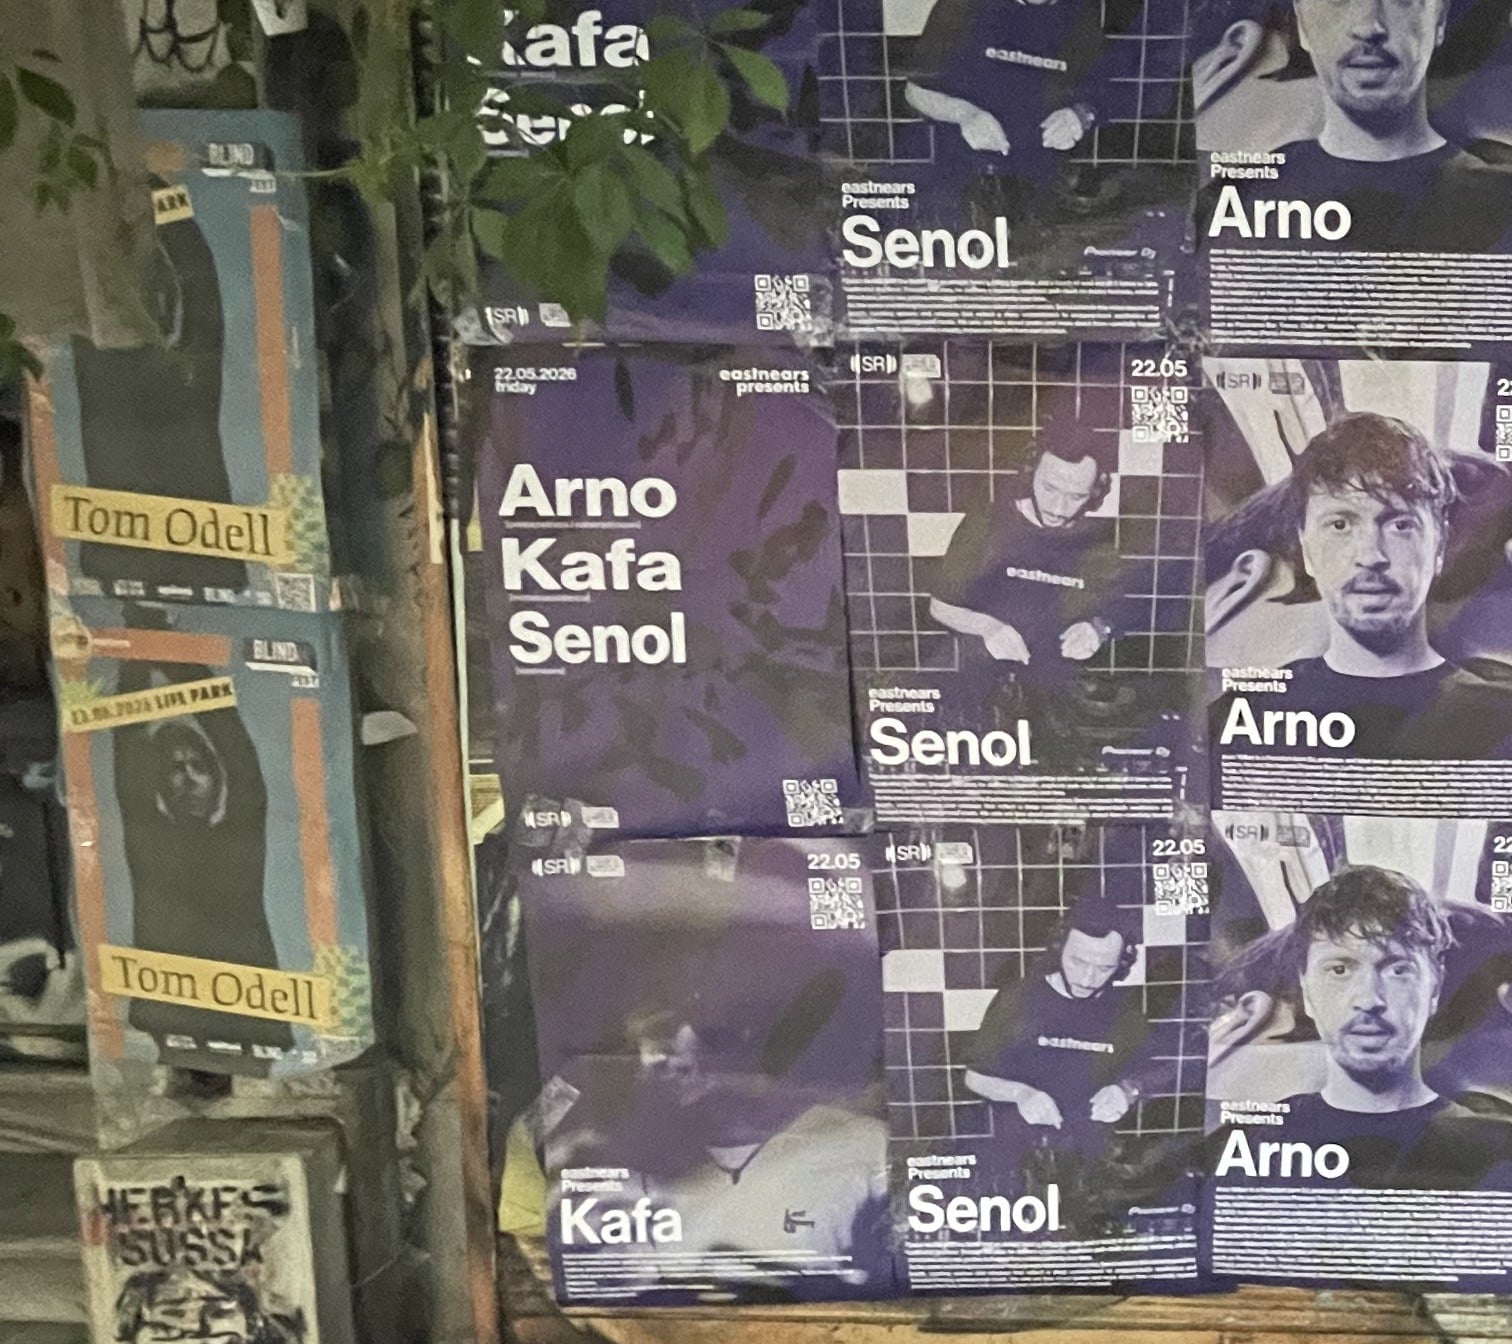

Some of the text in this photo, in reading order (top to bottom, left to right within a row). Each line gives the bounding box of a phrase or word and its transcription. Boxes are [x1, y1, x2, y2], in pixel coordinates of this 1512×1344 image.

[1210, 151, 1286, 165] eastnears
[1211, 165, 1278, 180] Presents
[841, 181, 915, 195] eastnears
[842, 195, 909, 210] Presents
[1208, 185, 1351, 240] Arno
[842, 215, 1009, 269] Senol
[492, 306, 520, 325] SR
[862, 357, 885, 373] SR
[1132, 359, 1188, 378] 22.05
[494, 368, 577, 381] 22.05.2026
[720, 369, 810, 381] eastnears
[1228, 373, 1251, 388] SR
[736, 381, 809, 396] presents
[500, 464, 677, 518] Arno
[65, 495, 275, 557] Tom Odell
[502, 538, 682, 591] Kafa
[508, 611, 687, 665] Senol
[1221, 668, 1293, 680] eastnears
[869, 687, 941, 700] eastnears
[1221, 679, 1287, 694] Presents
[869, 699, 935, 713] Presents
[1220, 697, 1356, 748] Arno
[869, 718, 1032, 766] Senol
[1235, 825, 1259, 841] SR
[896, 845, 921, 860] SR
[1152, 839, 1206, 856] 22.05
[543, 859, 569, 874] SR
[807, 853, 861, 870] 22.05
[112, 955, 316, 1019] Tom Odell
[1220, 1099, 1291, 1113] eastnears
[1221, 1111, 1284, 1126] Presents
[907, 1155, 977, 1167] eastnears
[1215, 1129, 1349, 1178] Arno
[908, 1166, 971, 1180] Presents
[561, 1179, 624, 1193] Presents
[908, 1183, 1060, 1232] Senol
[560, 1198, 683, 1245] Kafa
